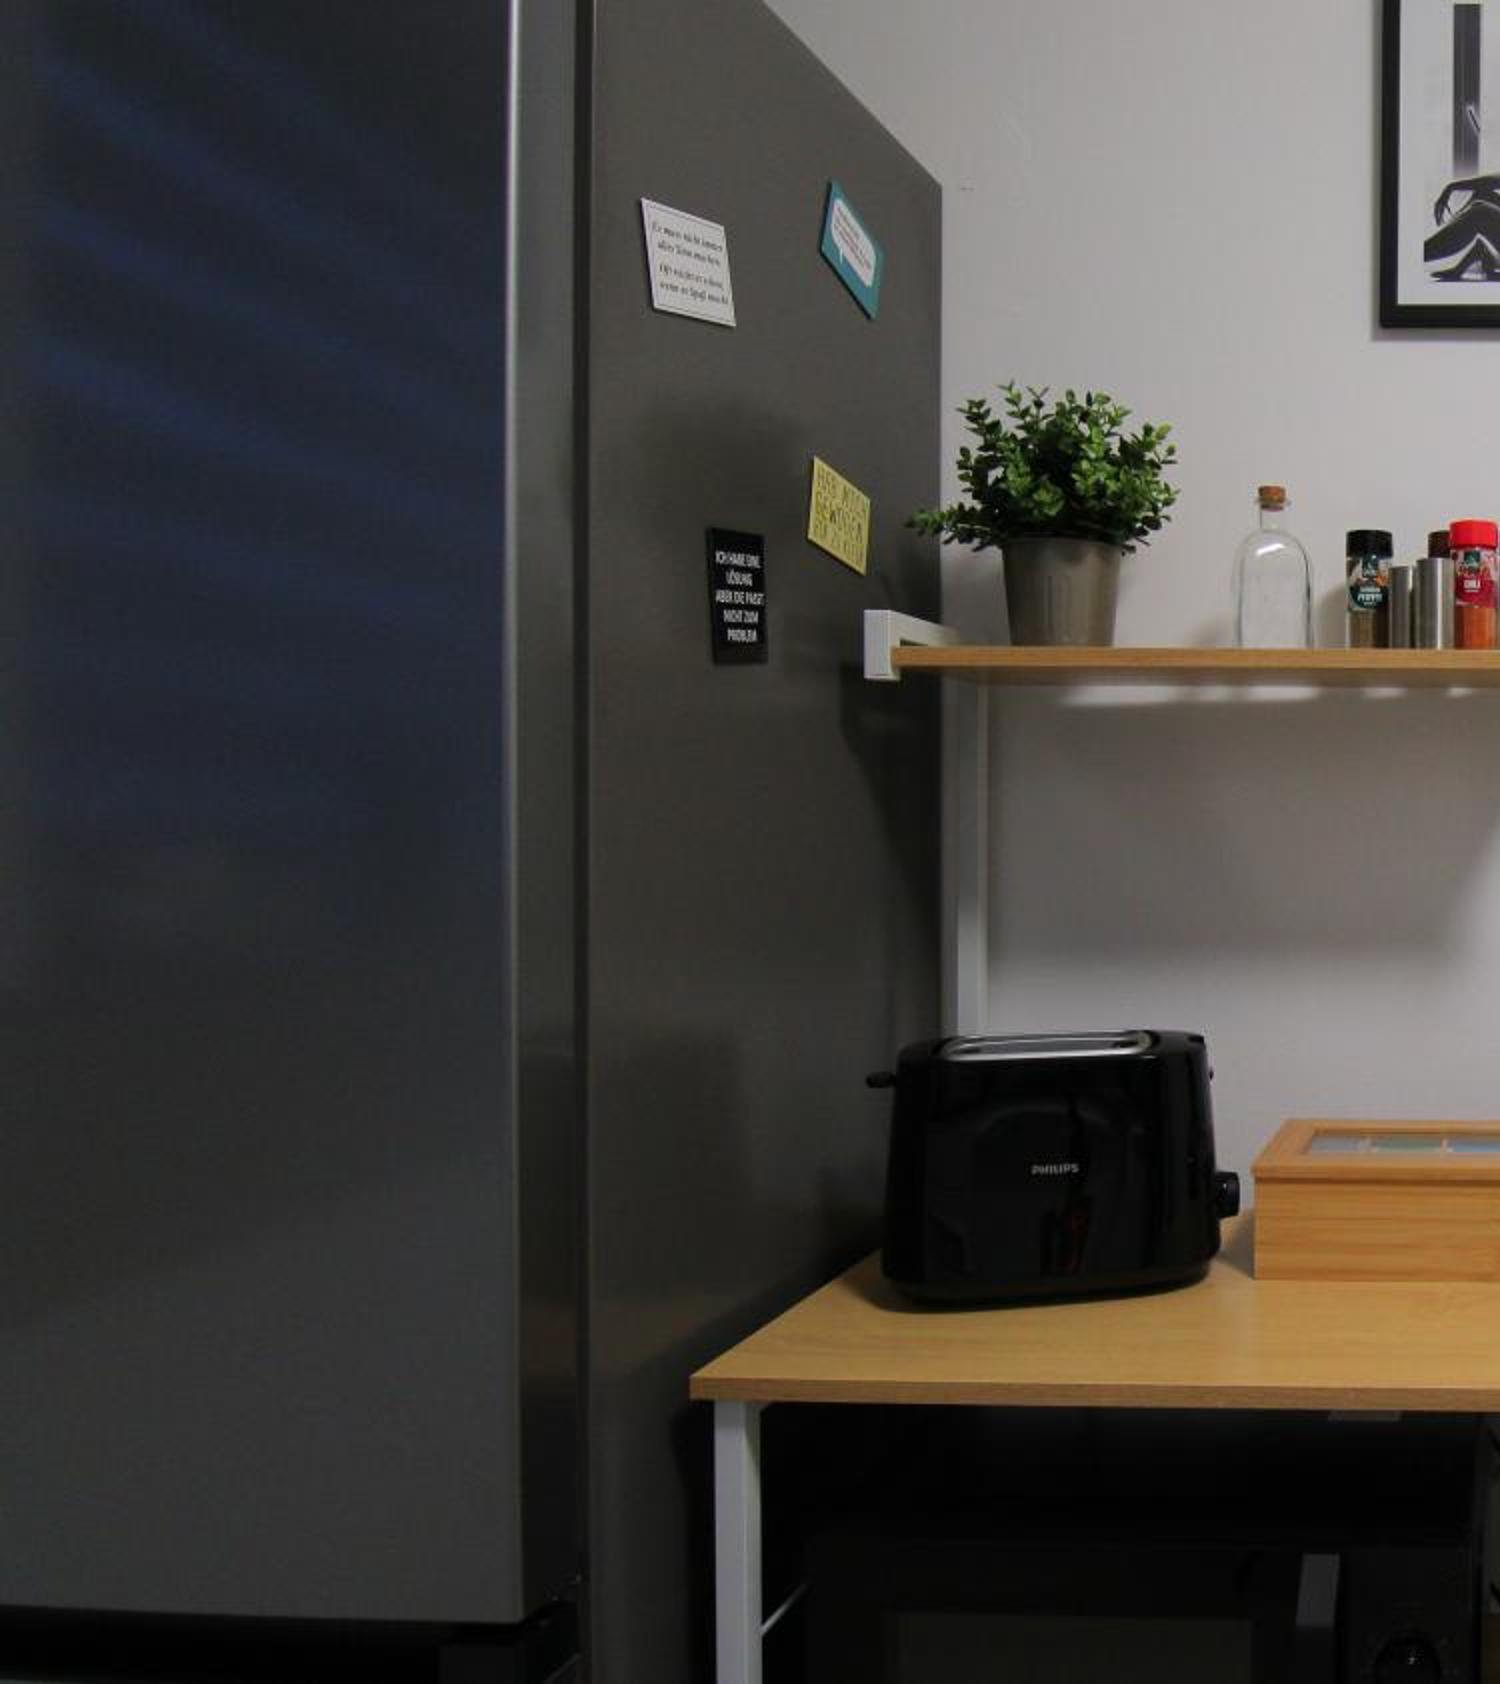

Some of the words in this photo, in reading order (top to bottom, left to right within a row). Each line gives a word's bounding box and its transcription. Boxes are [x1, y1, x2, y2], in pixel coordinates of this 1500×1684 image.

[715, 551, 727, 564] ICH
[726, 551, 744, 566] HABE
[745, 553, 760, 569] EINE
[725, 568, 753, 587] LÖSUNG
[715, 589, 733, 603] ABER
[735, 590, 745, 605] DIE
[723, 609, 742, 623] NICHT
[743, 610, 759, 625] ZUM
[727, 628, 758, 643] PROBLEM
[1031, 1163, 1080, 1175] PHILIPS
